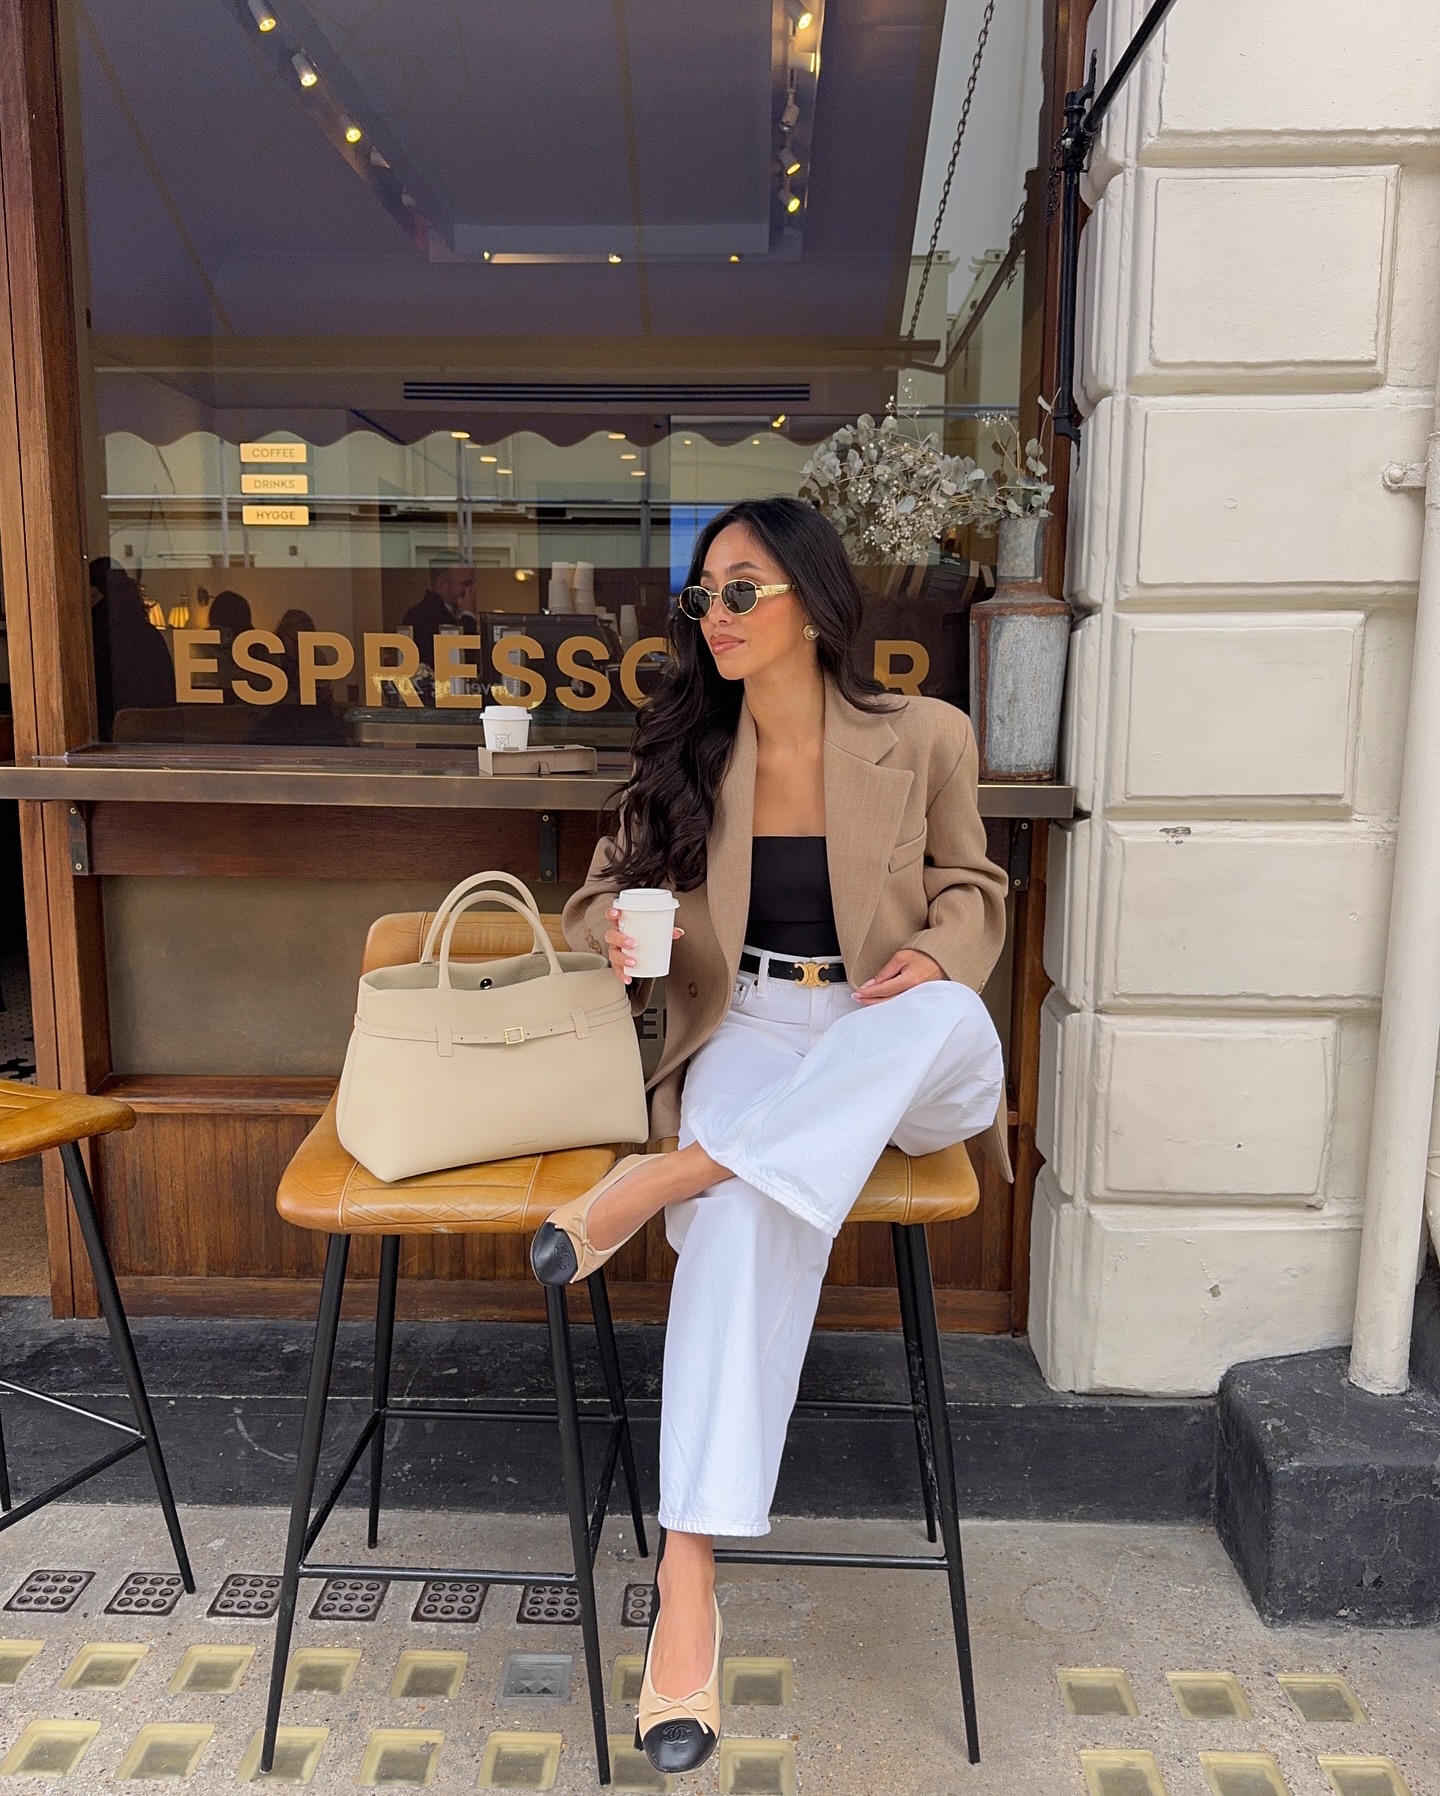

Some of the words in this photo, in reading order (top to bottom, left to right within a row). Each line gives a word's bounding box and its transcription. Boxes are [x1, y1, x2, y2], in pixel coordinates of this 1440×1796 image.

[252, 448, 296, 458] COFFEE
[253, 479, 296, 490] DRINKS
[256, 510, 297, 521] HYGGE
